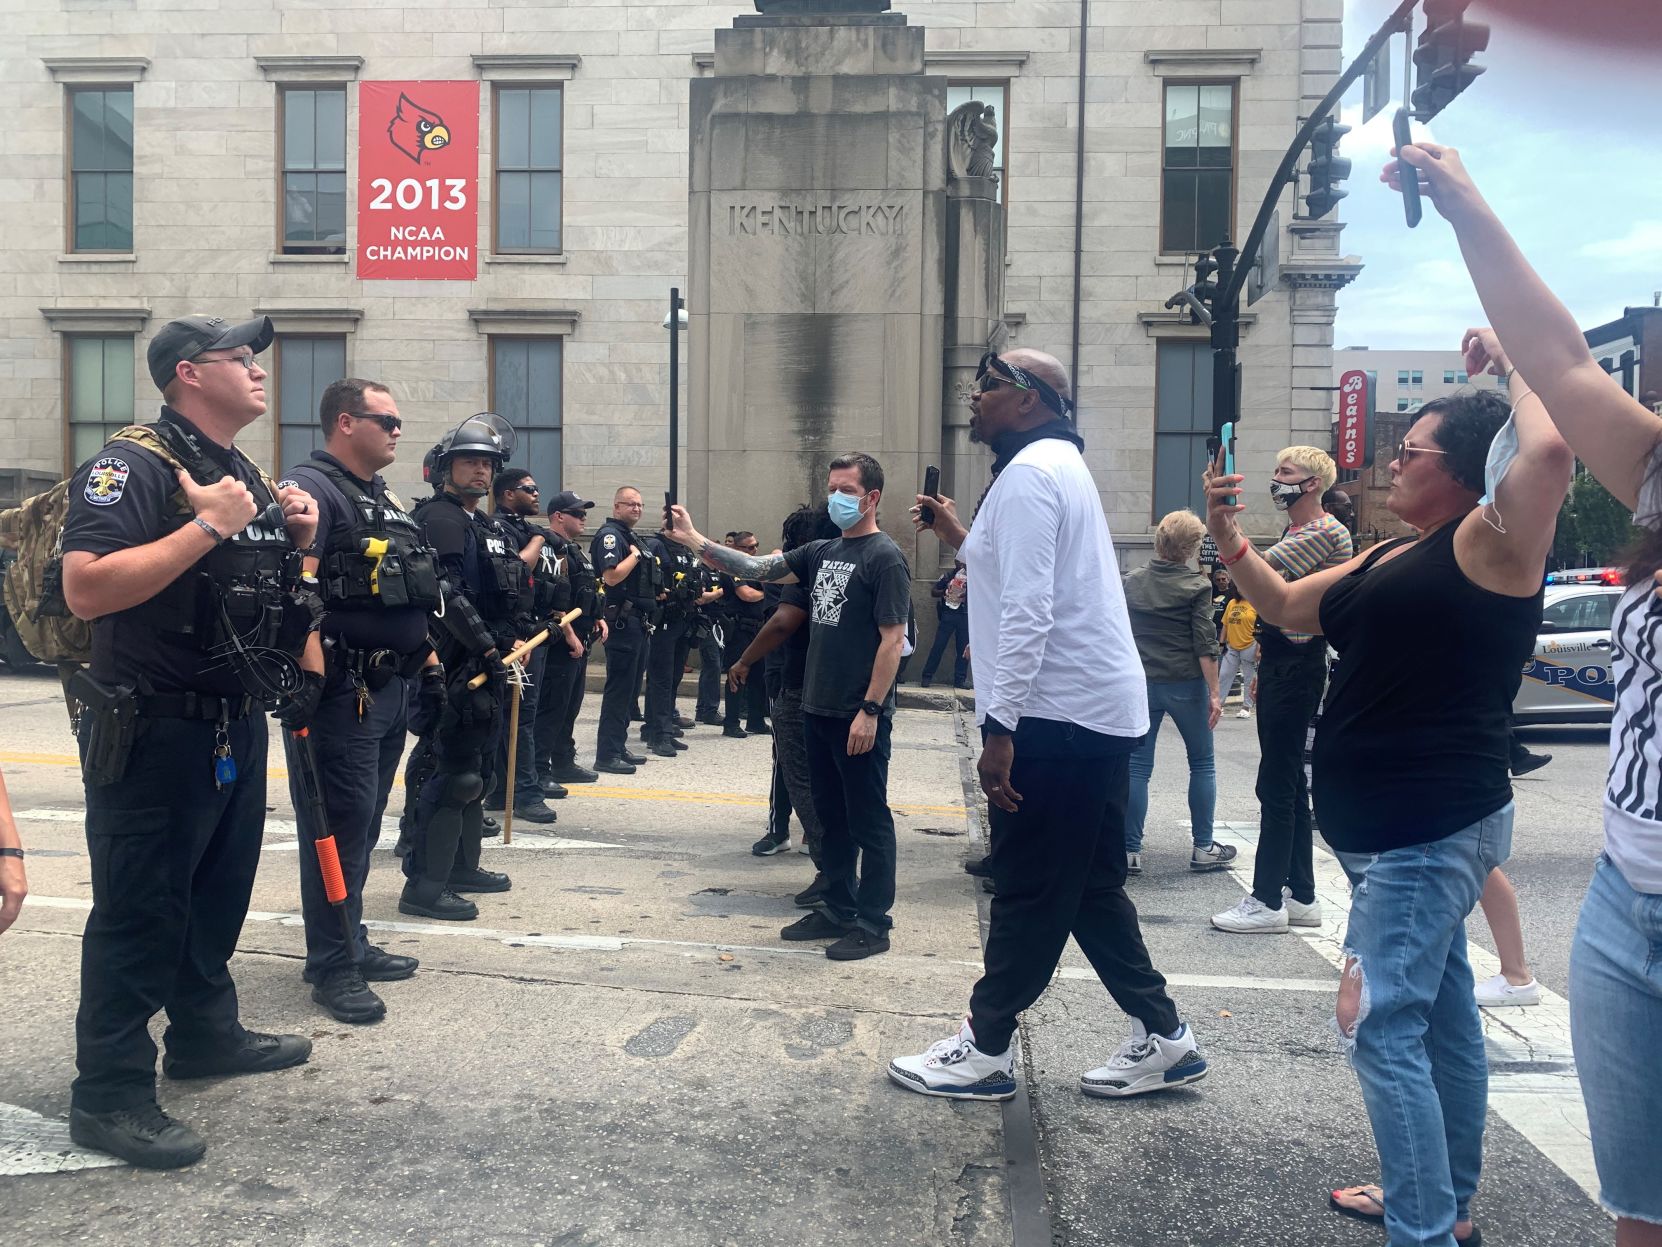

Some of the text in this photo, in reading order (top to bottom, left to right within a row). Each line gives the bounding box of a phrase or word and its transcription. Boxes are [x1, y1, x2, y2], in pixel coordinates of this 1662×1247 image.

[369, 178, 467, 211] 2013
[728, 205, 904, 236] KENTUCKY
[390, 226, 445, 241] NCAA
[366, 246, 469, 261] CHAMPION
[1343, 375, 1363, 463] Bearno's
[94, 459, 128, 472] POLICE
[821, 559, 857, 573] WAYLON
[1542, 642, 1593, 654] Louisville
